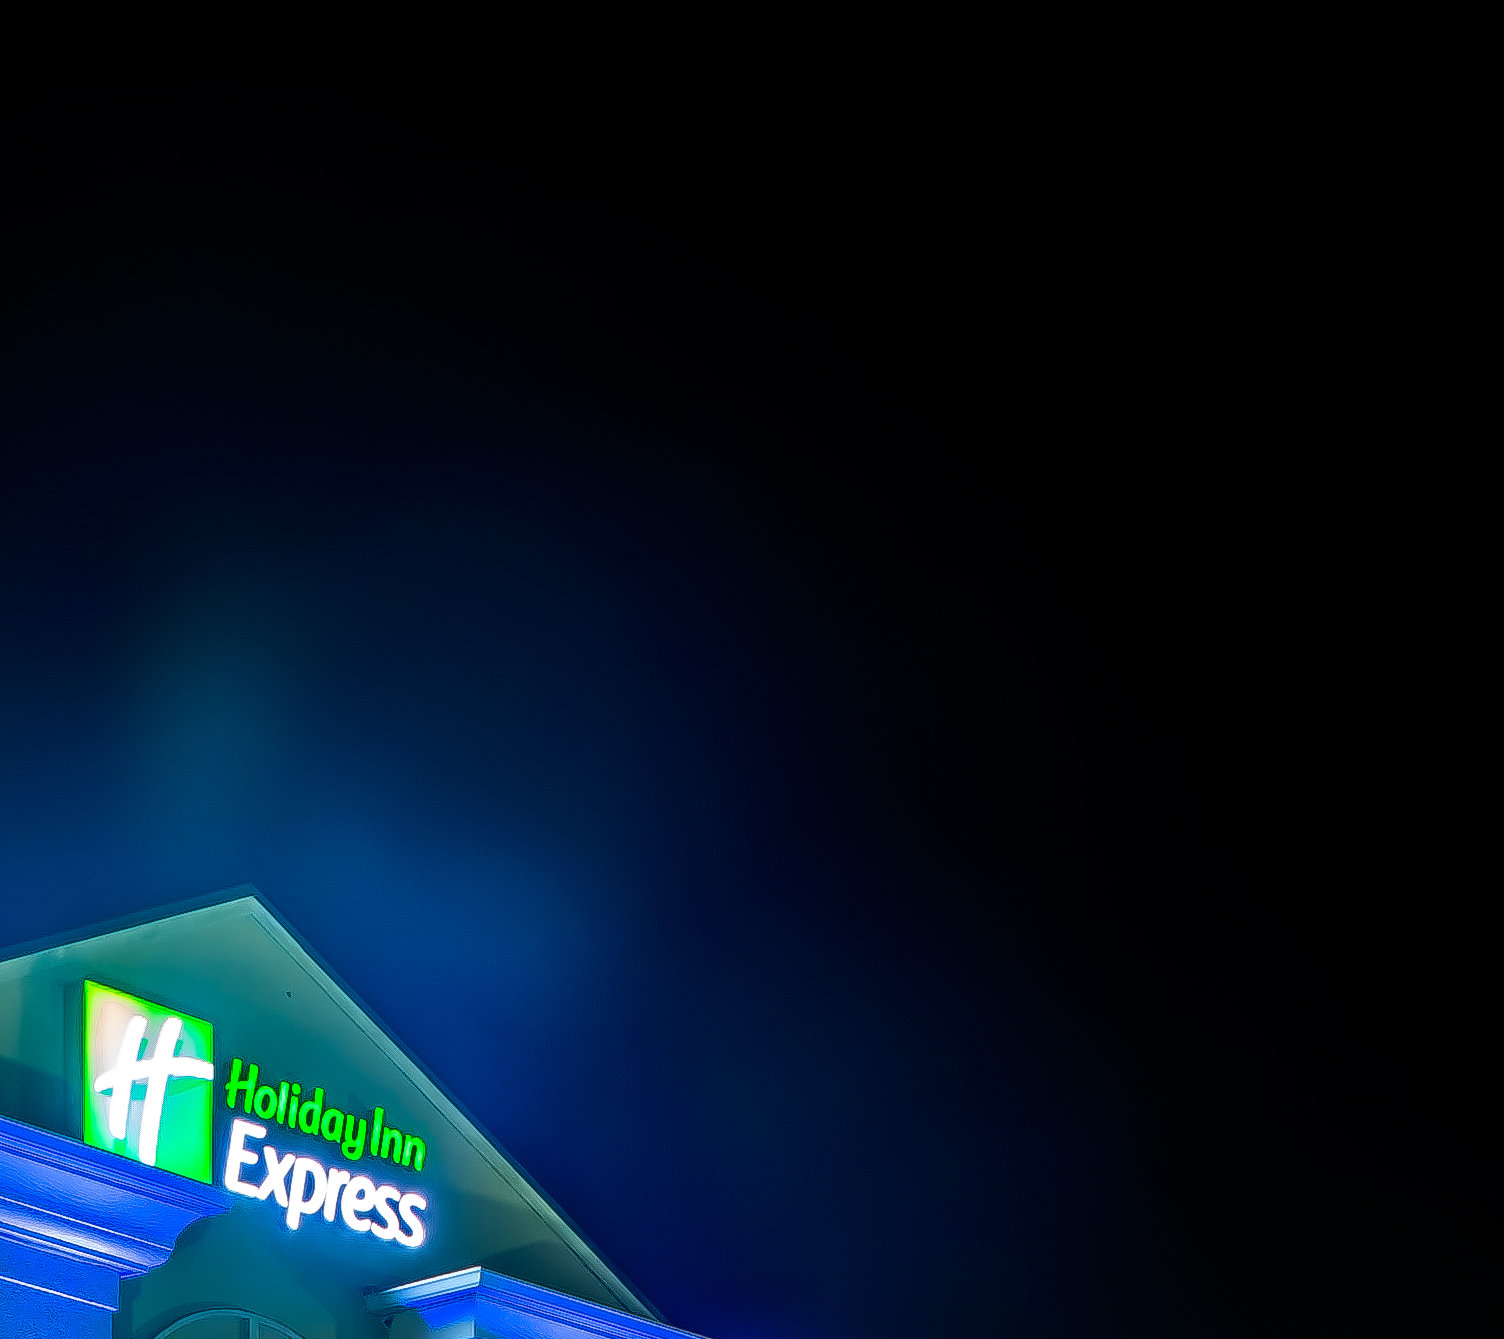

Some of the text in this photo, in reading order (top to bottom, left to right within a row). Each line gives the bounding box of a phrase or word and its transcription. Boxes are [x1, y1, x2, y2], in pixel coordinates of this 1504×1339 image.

[93, 1015, 214, 1166] H
[226, 1058, 426, 1172] Holiday Inn
[224, 1118, 428, 1248] Express
